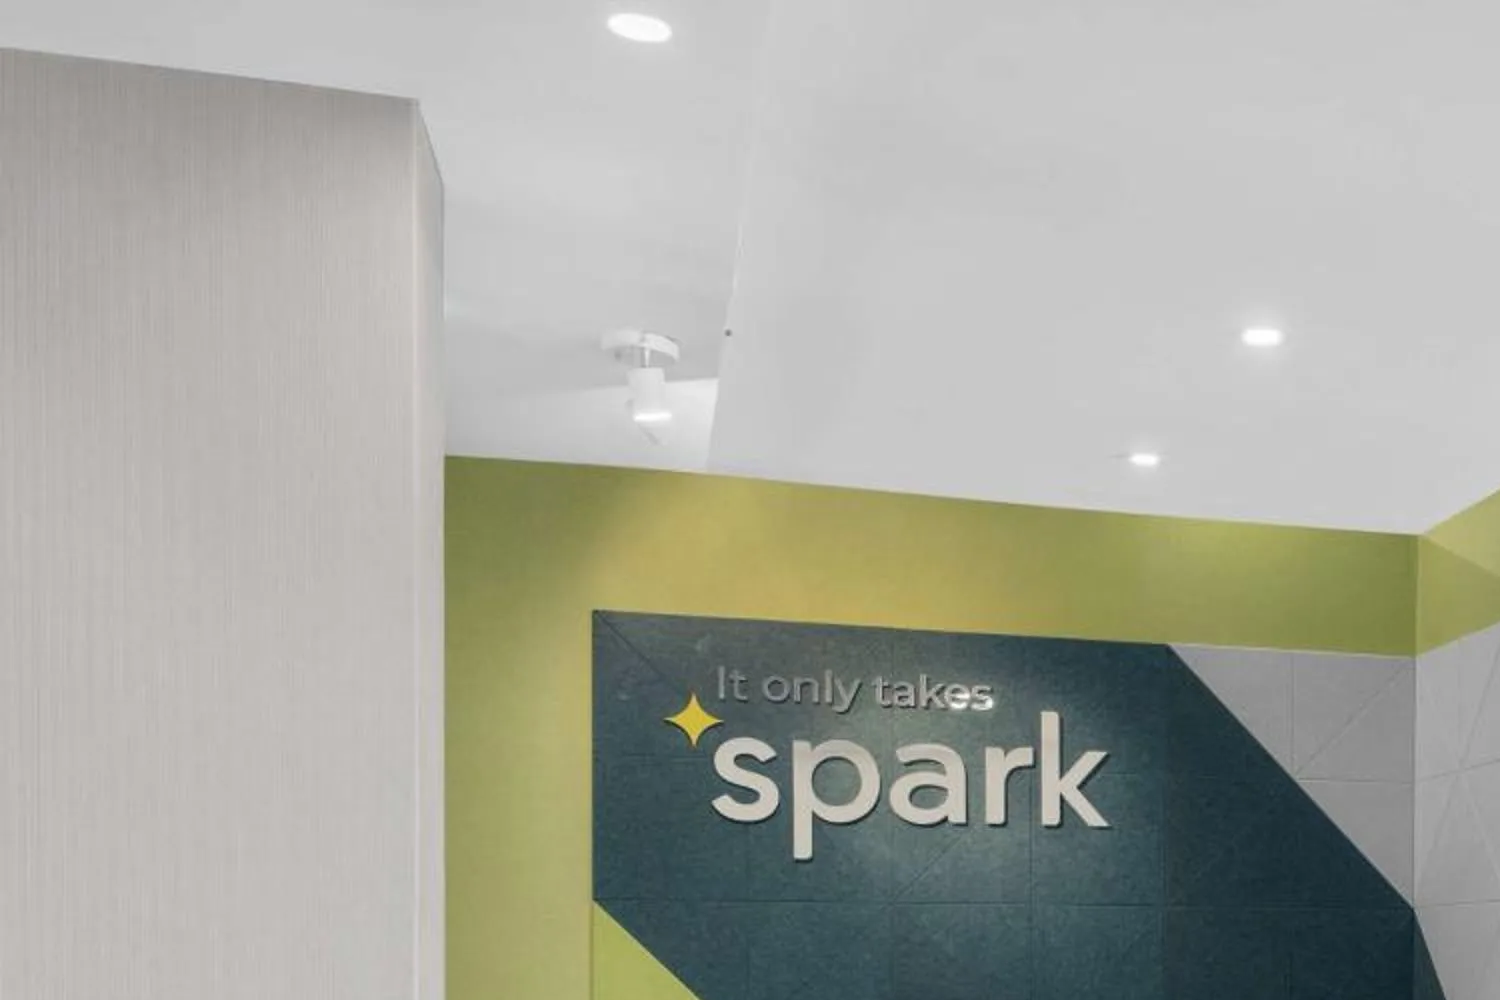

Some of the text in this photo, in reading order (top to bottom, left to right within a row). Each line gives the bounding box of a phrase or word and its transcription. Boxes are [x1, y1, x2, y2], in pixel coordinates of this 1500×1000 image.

[716, 666, 995, 714] It only takes
[711, 711, 1111, 861] spark
